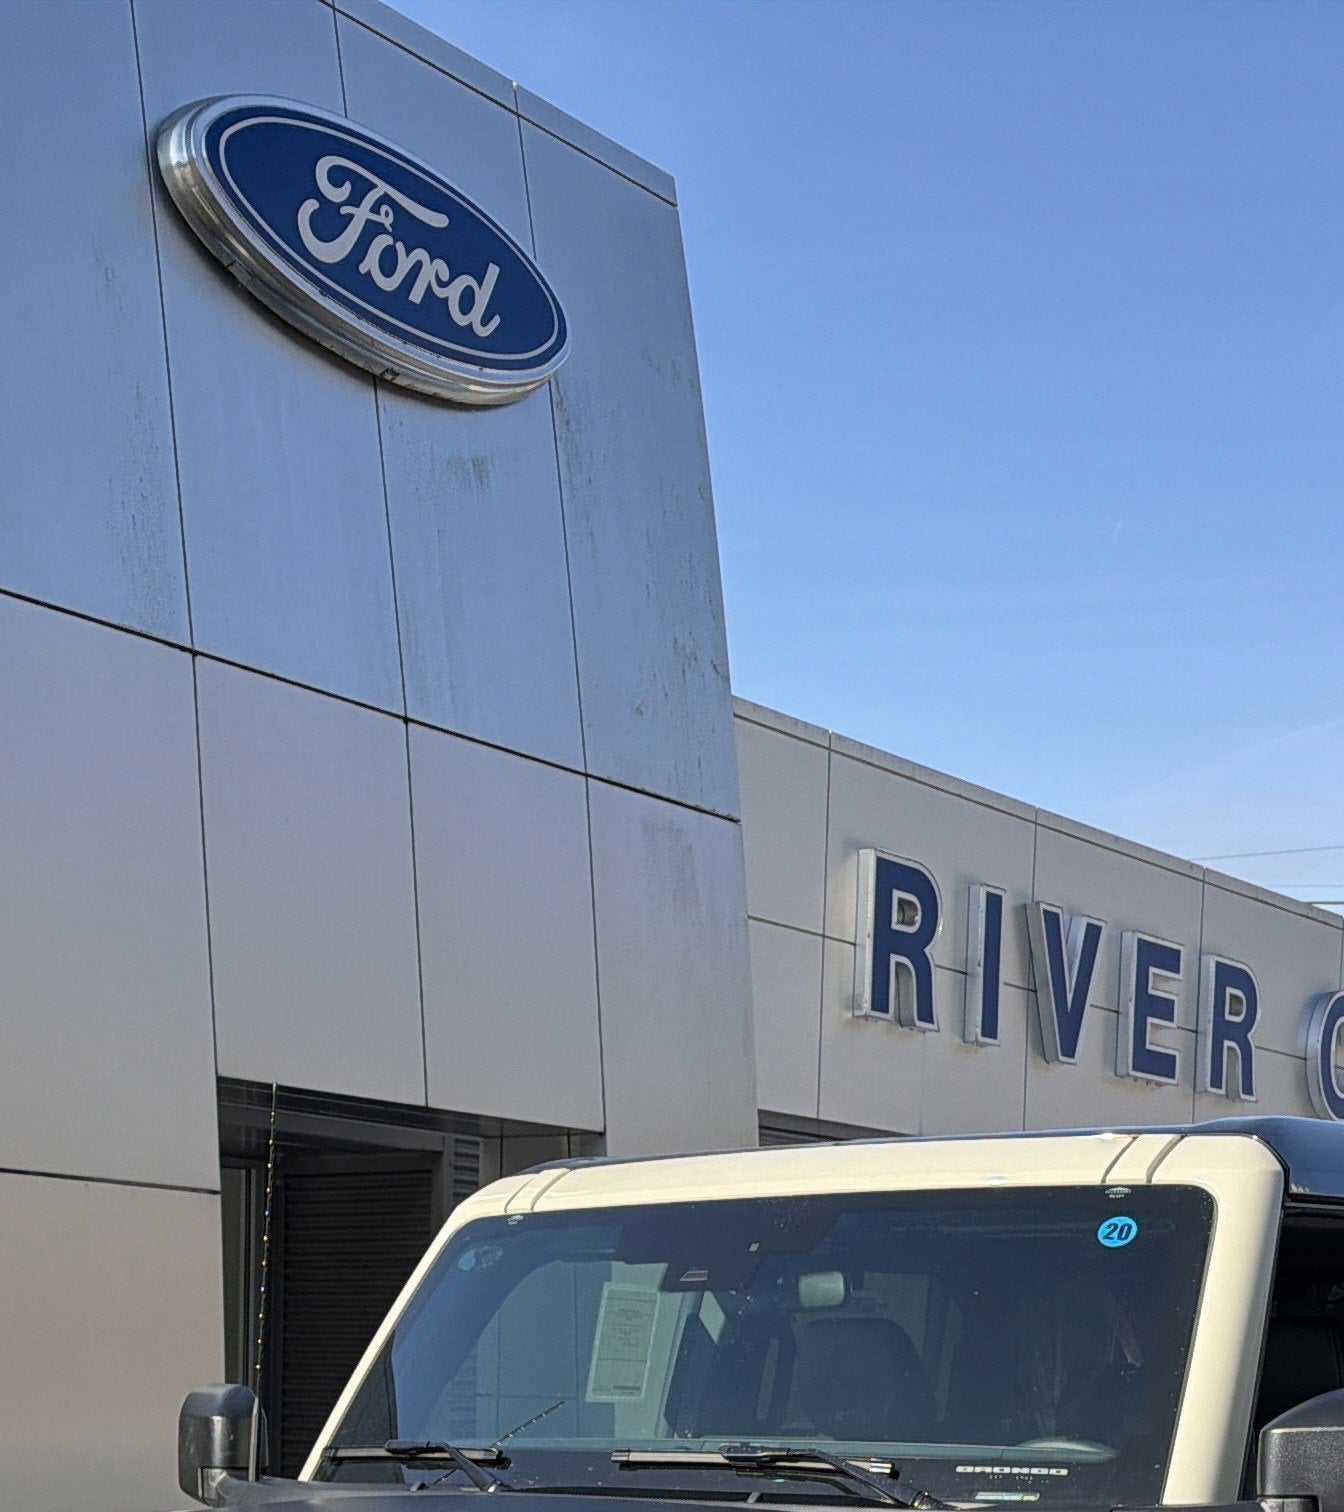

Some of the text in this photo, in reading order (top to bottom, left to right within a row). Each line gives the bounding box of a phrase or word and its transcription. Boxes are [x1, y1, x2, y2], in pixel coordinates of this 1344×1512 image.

[297, 155, 500, 338] Ford
[856, 848, 1257, 1102] RIVER
[1101, 1222, 1133, 1241] 20
